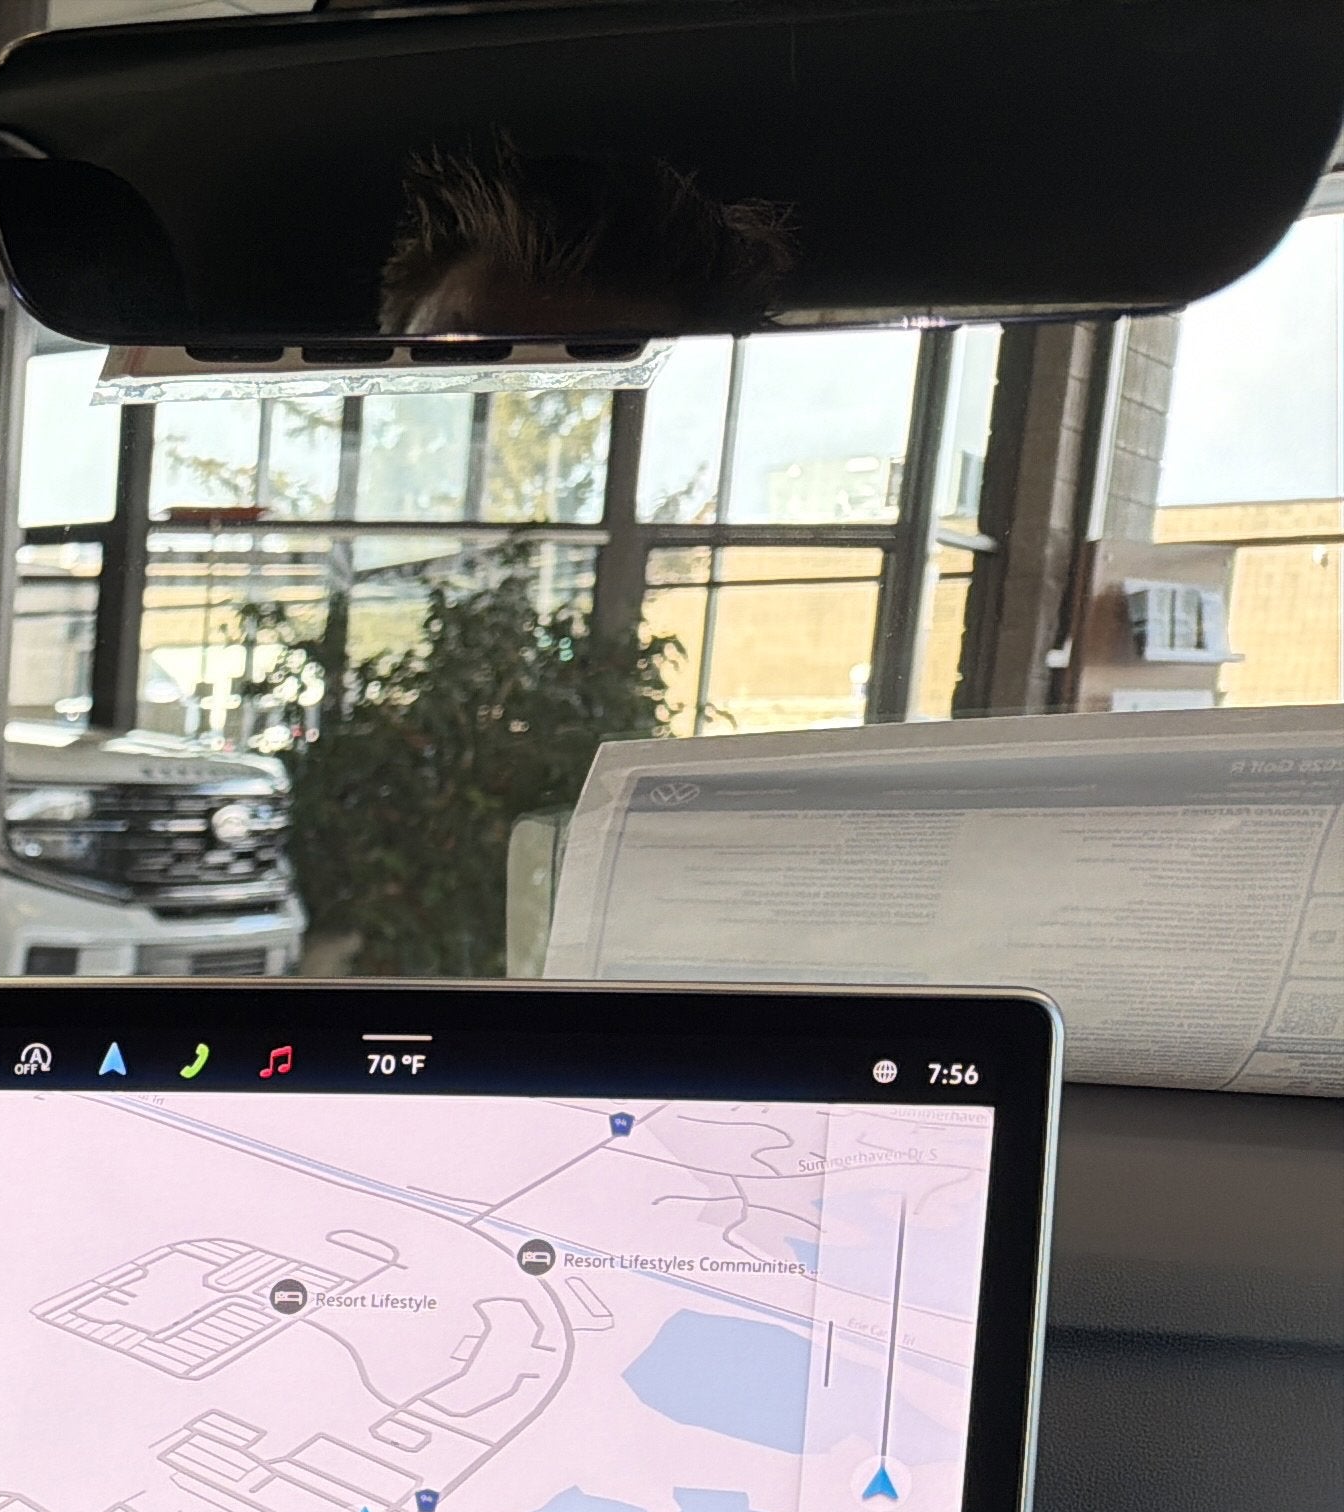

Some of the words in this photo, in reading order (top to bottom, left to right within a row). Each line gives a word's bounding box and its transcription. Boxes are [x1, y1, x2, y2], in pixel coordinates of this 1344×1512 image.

[14, 1063, 38, 1075] OFF
[367, 1054, 396, 1075] 70
[928, 1063, 980, 1086] 7:56
[563, 1253, 614, 1269] Resort
[619, 1254, 695, 1273] Lifestyles
[698, 1256, 806, 1275] Communities
[315, 1292, 367, 1308] Resort
[370, 1293, 438, 1313] Lifestyle
